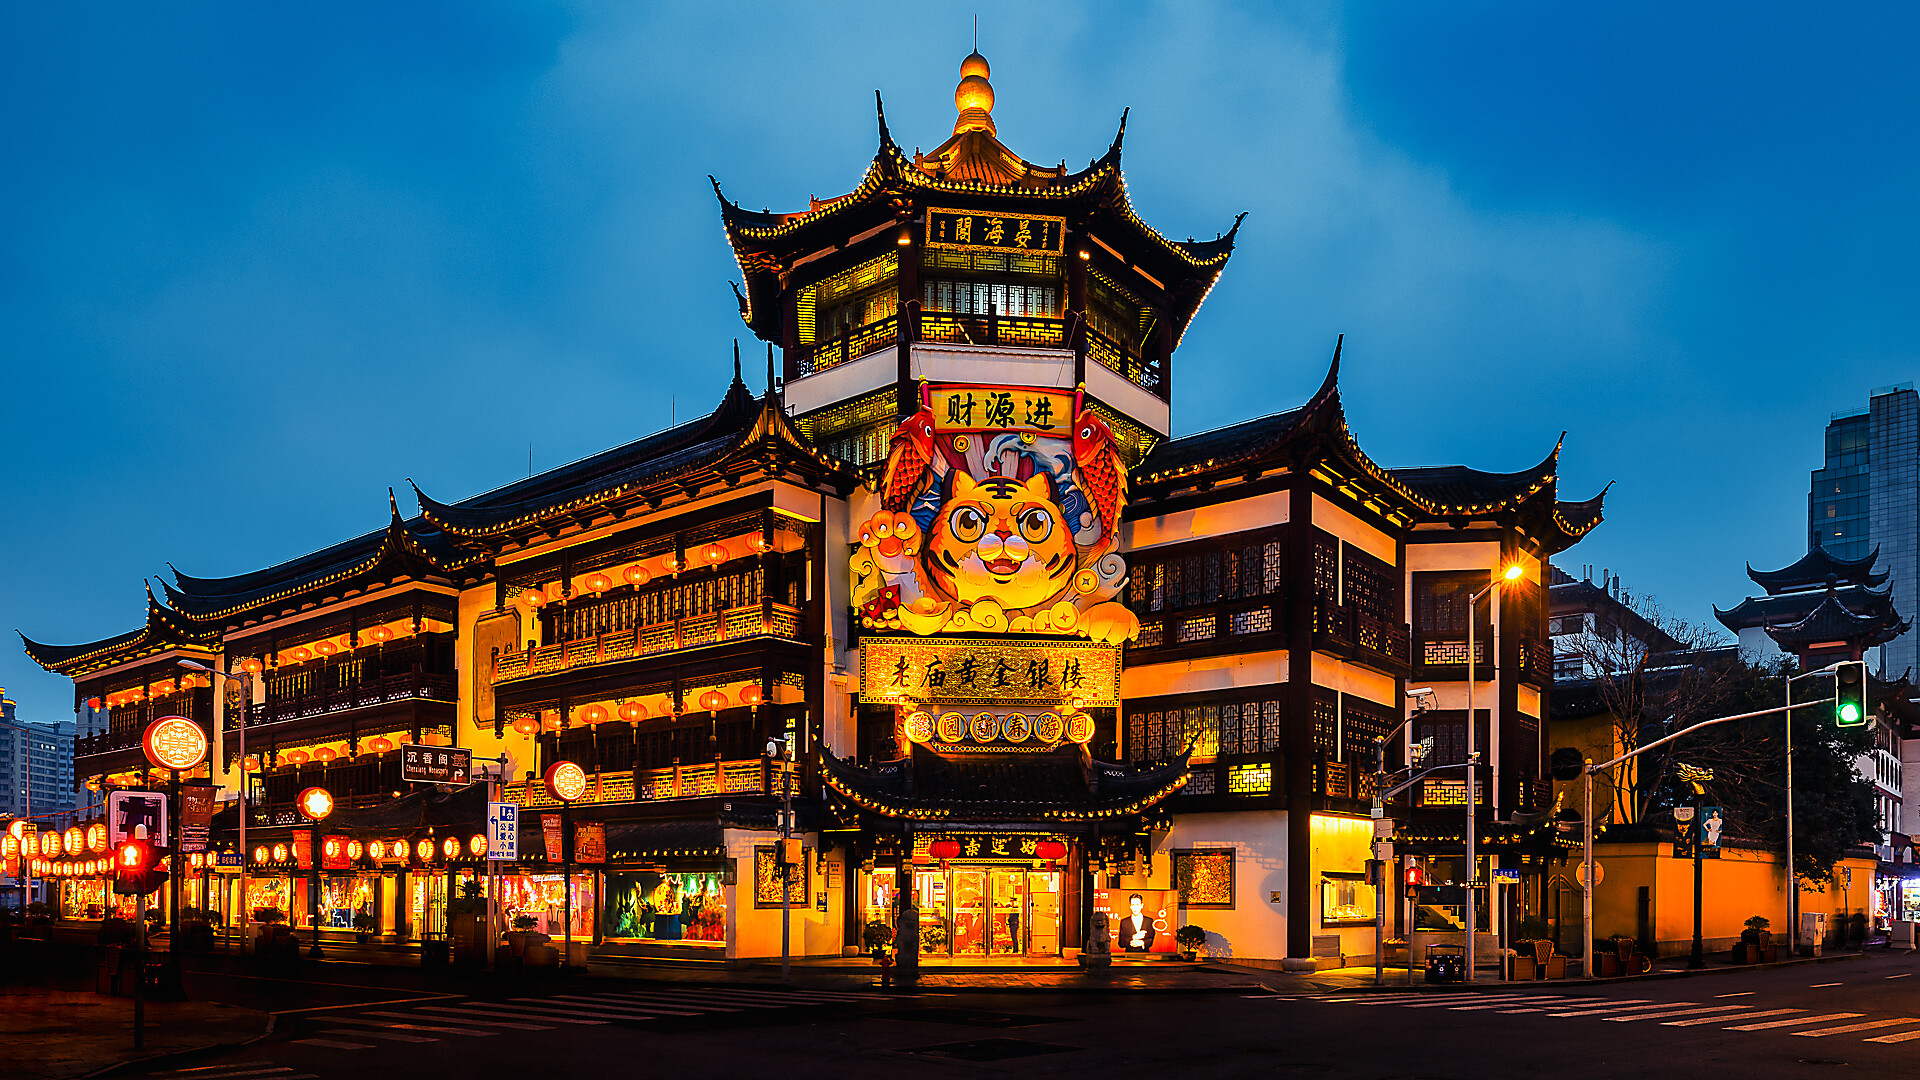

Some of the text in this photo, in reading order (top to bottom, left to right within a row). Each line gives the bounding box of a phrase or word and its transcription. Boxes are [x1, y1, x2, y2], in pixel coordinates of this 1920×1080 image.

[946, 391, 1055, 430] 财源进
[890, 654, 1087, 690] 老庙黄金银楼
[910, 713, 1087, 739] 豫园新春游园
[407, 751, 448, 765] 沉香阁
